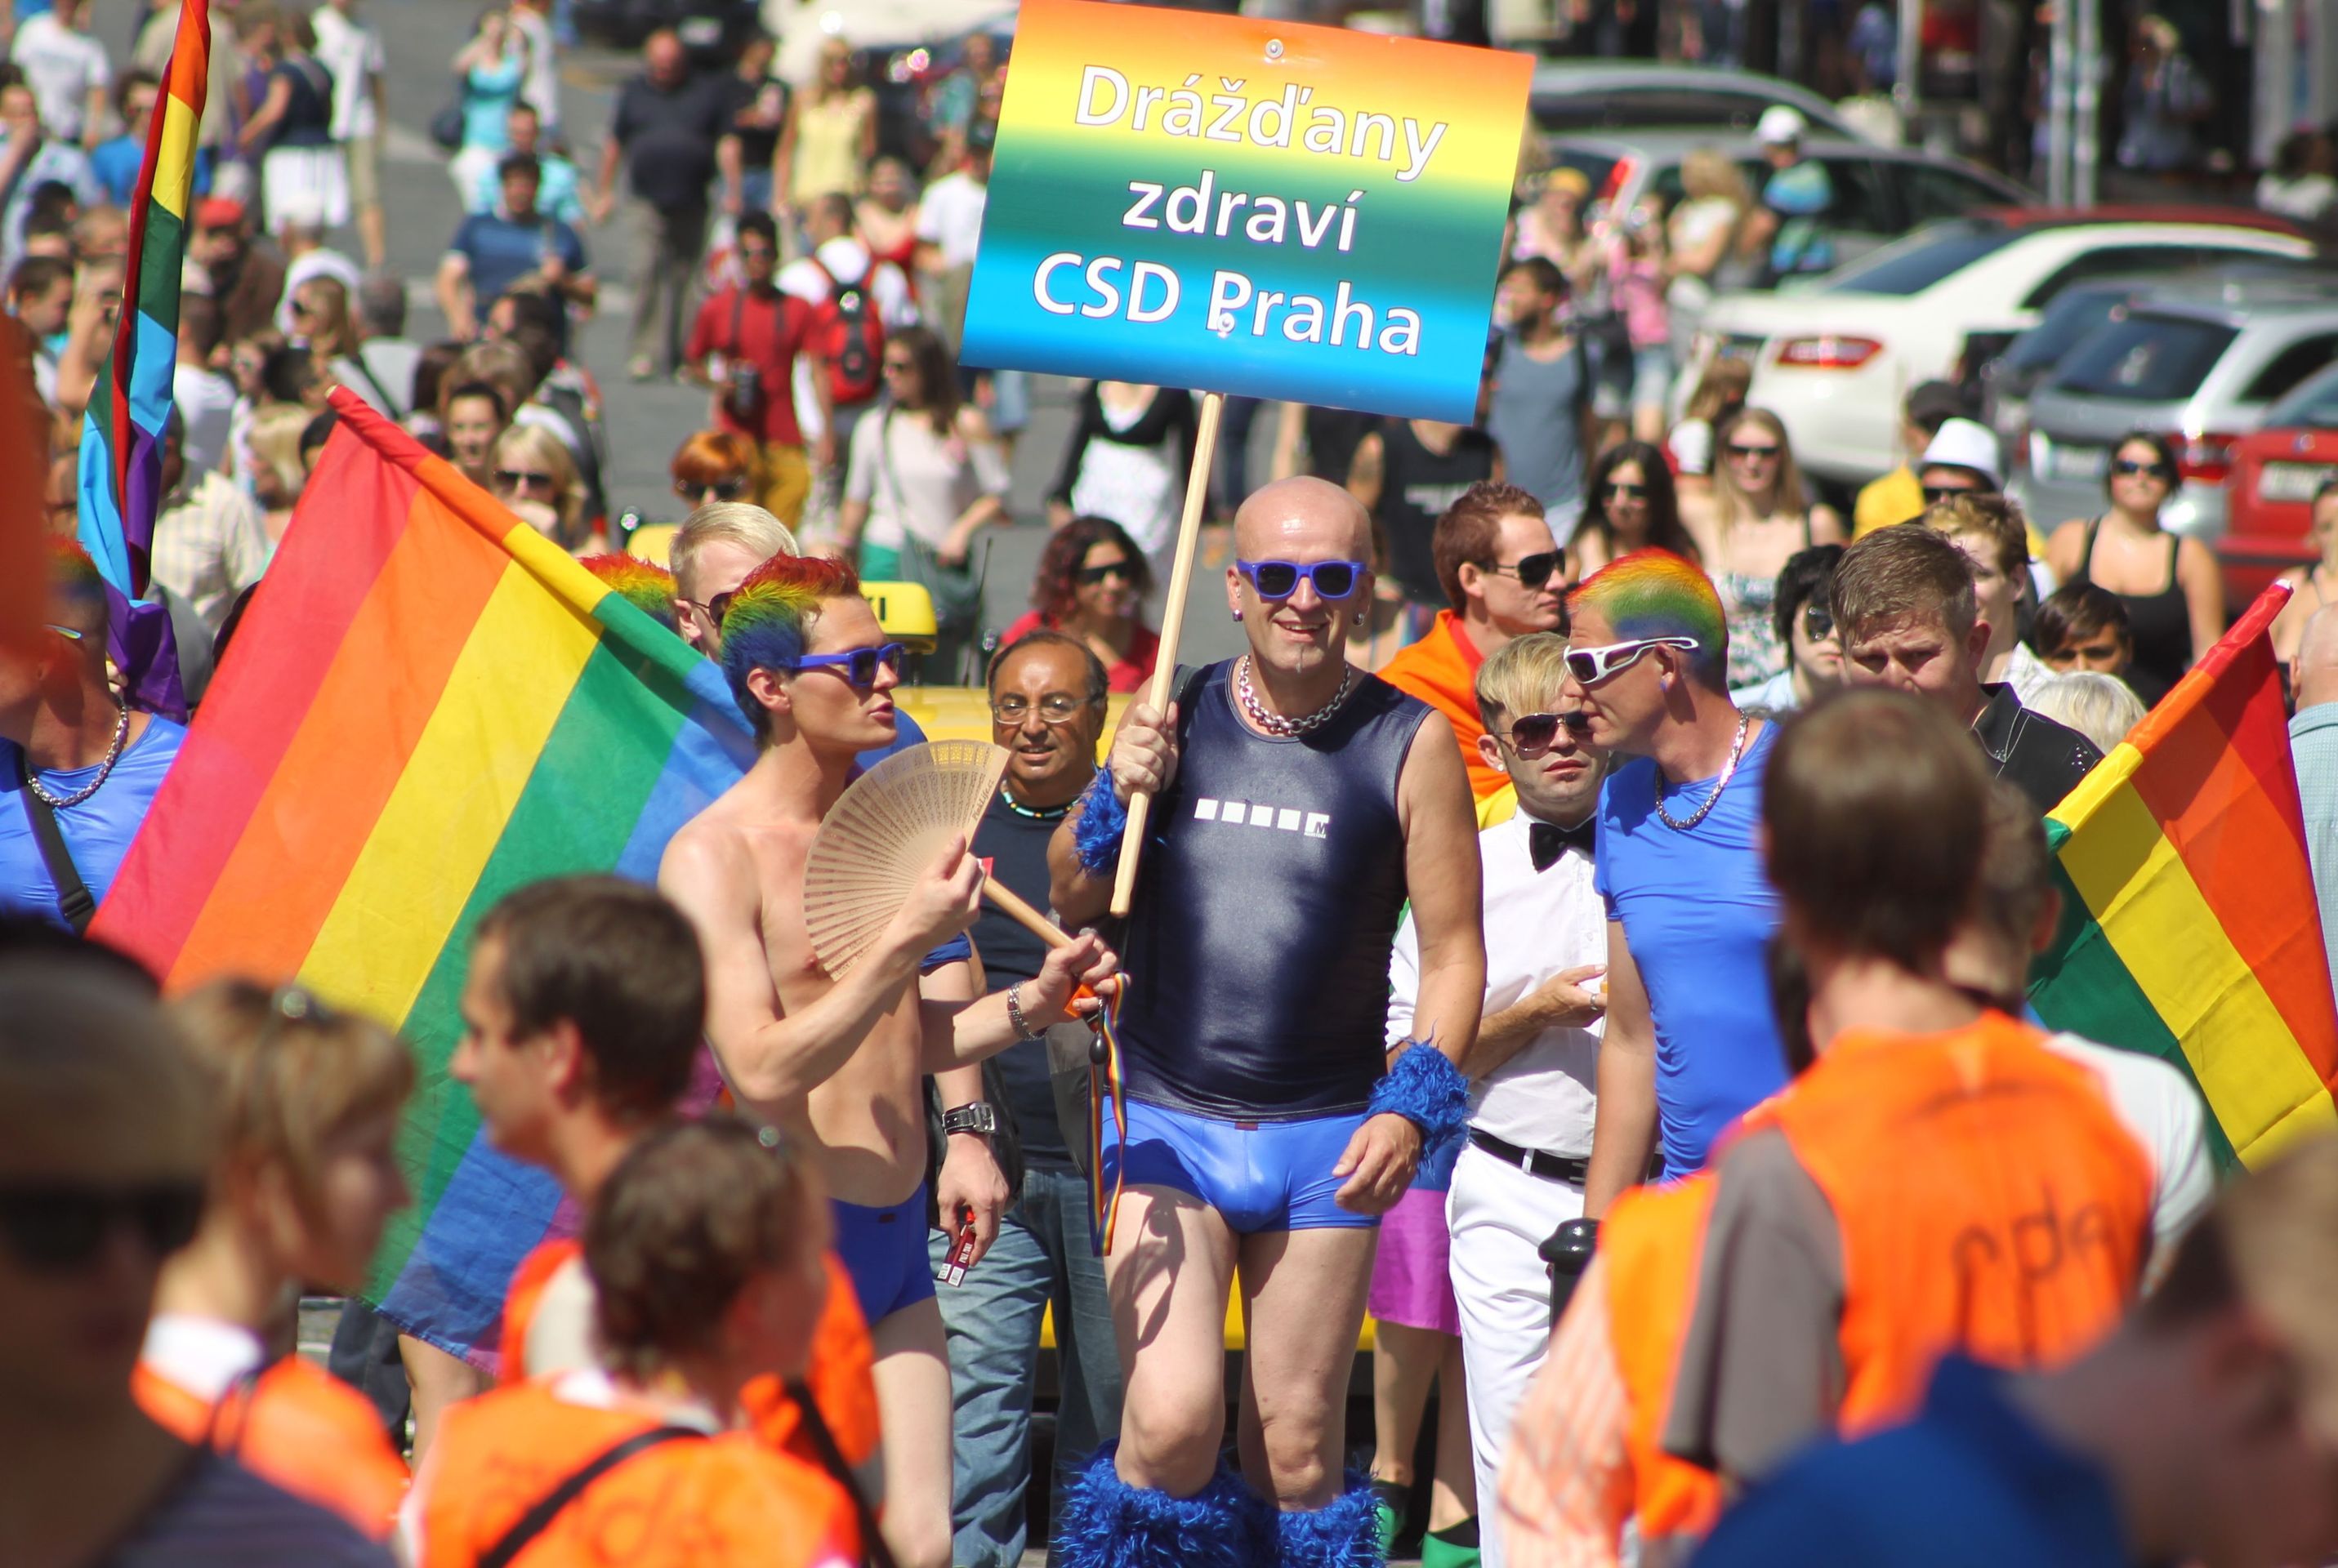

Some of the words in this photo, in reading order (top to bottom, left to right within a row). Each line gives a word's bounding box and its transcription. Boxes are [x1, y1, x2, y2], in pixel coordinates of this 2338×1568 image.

[1075, 65, 1448, 181] Drážďany
[1122, 169, 1367, 252] zdraví
[1033, 252, 1181, 323] CSD
[1207, 270, 1421, 355] Praha
